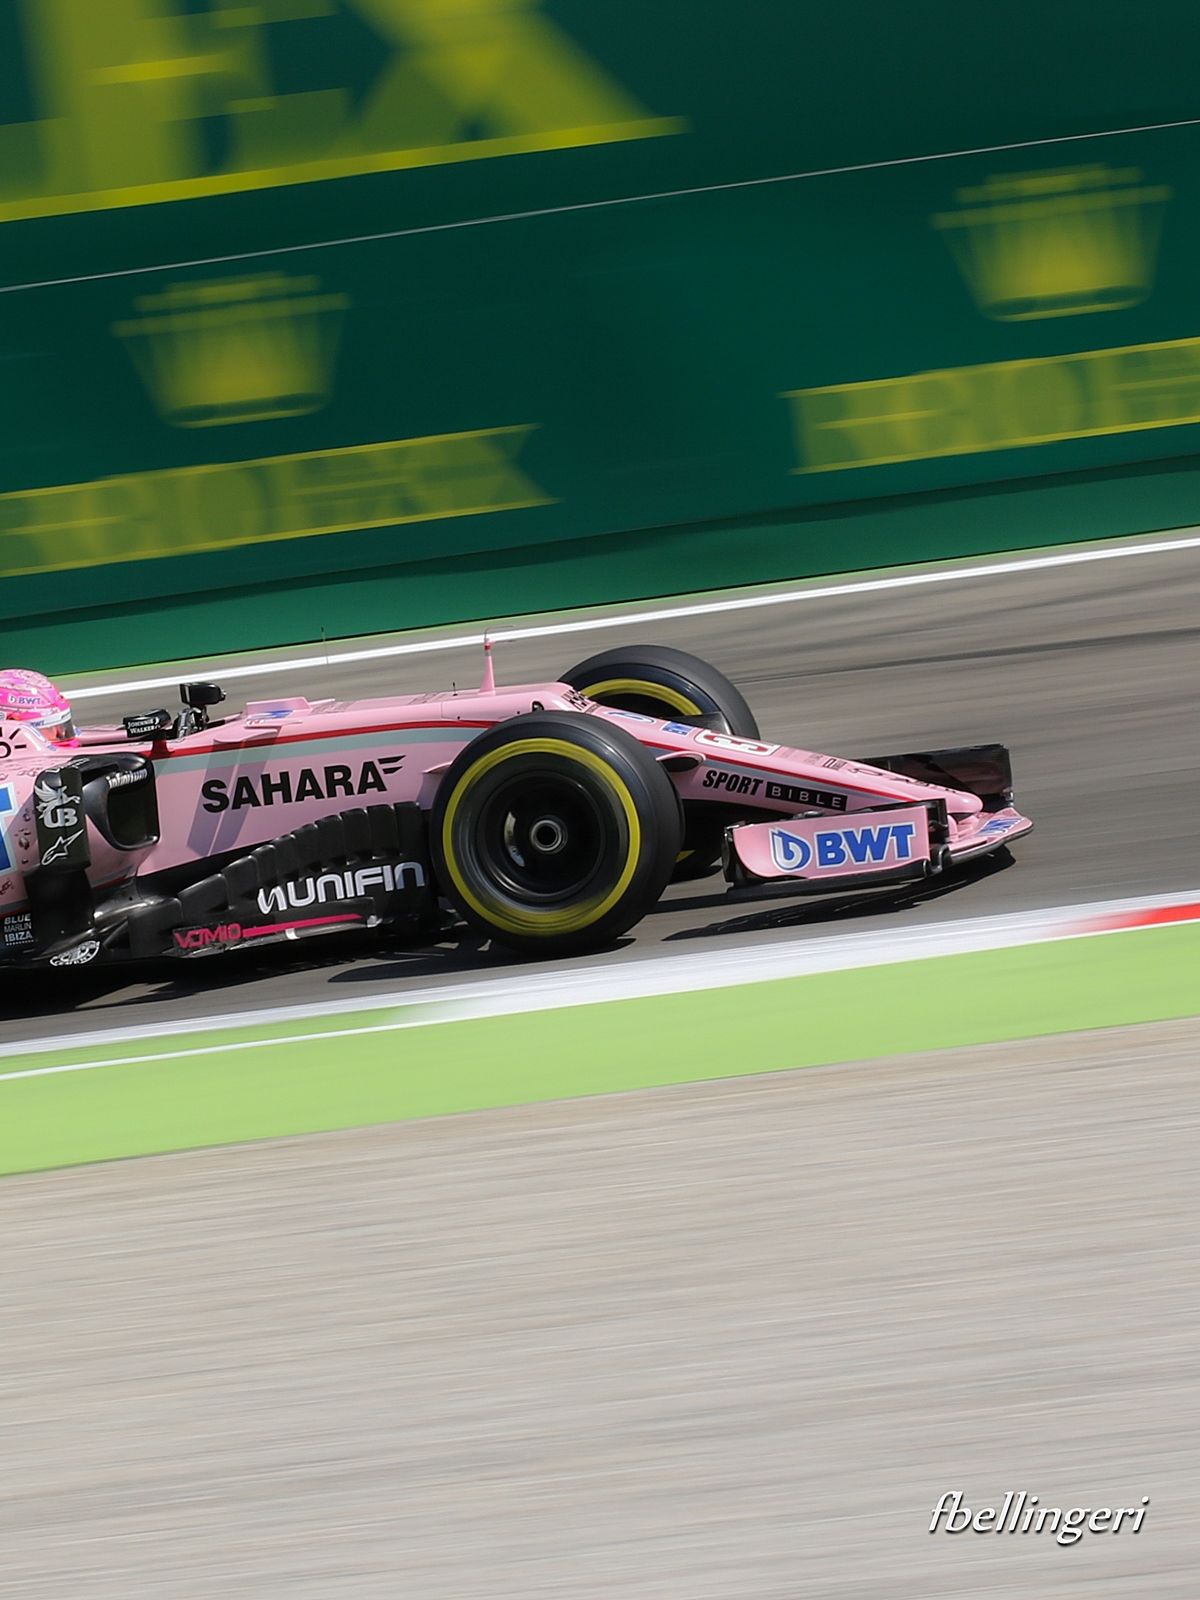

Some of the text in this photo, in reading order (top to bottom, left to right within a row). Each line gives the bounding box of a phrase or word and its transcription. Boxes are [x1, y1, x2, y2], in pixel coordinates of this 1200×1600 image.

[201, 762, 387, 813] SAHARA
[702, 769, 842, 808] SPORT BIBLE
[815, 823, 916, 867] BWT
[4, 913, 31, 925] BLUE
[4, 931, 33, 942] IBIZA
